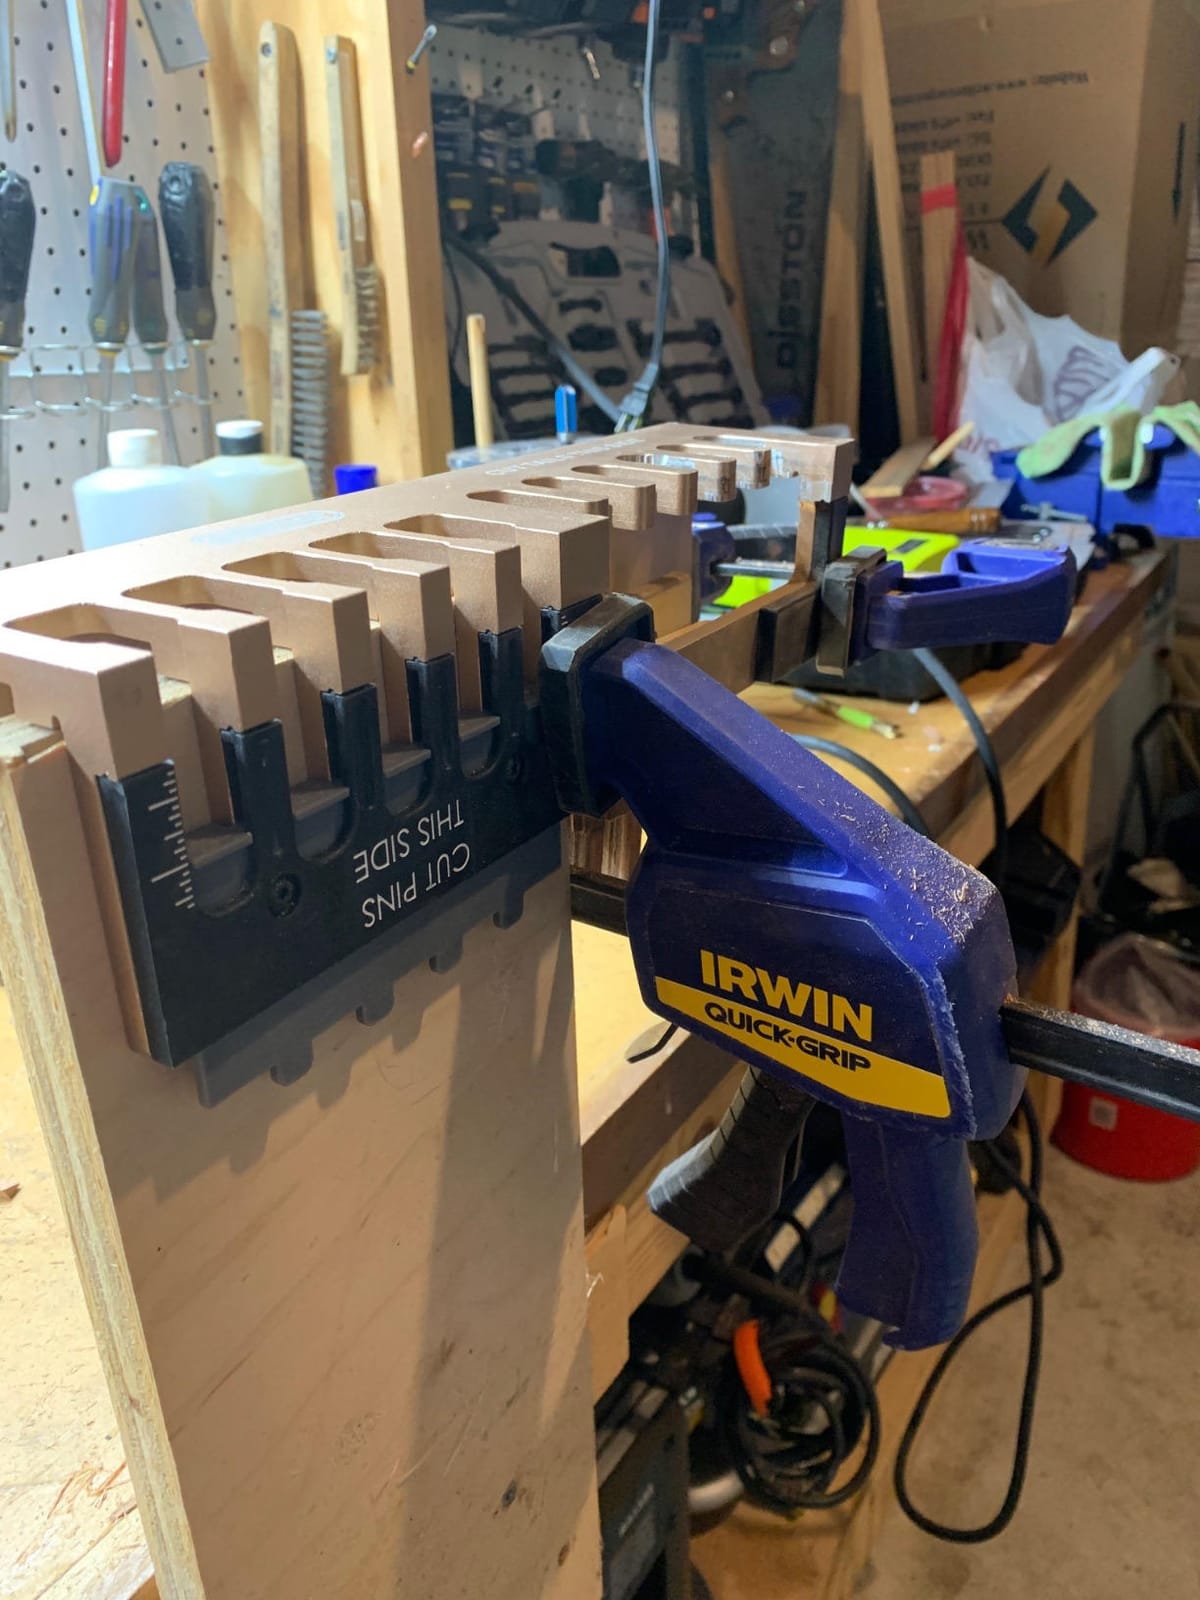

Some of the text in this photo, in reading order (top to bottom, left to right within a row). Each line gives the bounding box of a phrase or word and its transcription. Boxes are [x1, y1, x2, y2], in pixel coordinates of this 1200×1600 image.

[352, 799, 464, 884] THIS SIDE
[361, 842, 470, 928] CUT PINS
[700, 949, 873, 1042] IRWIN
